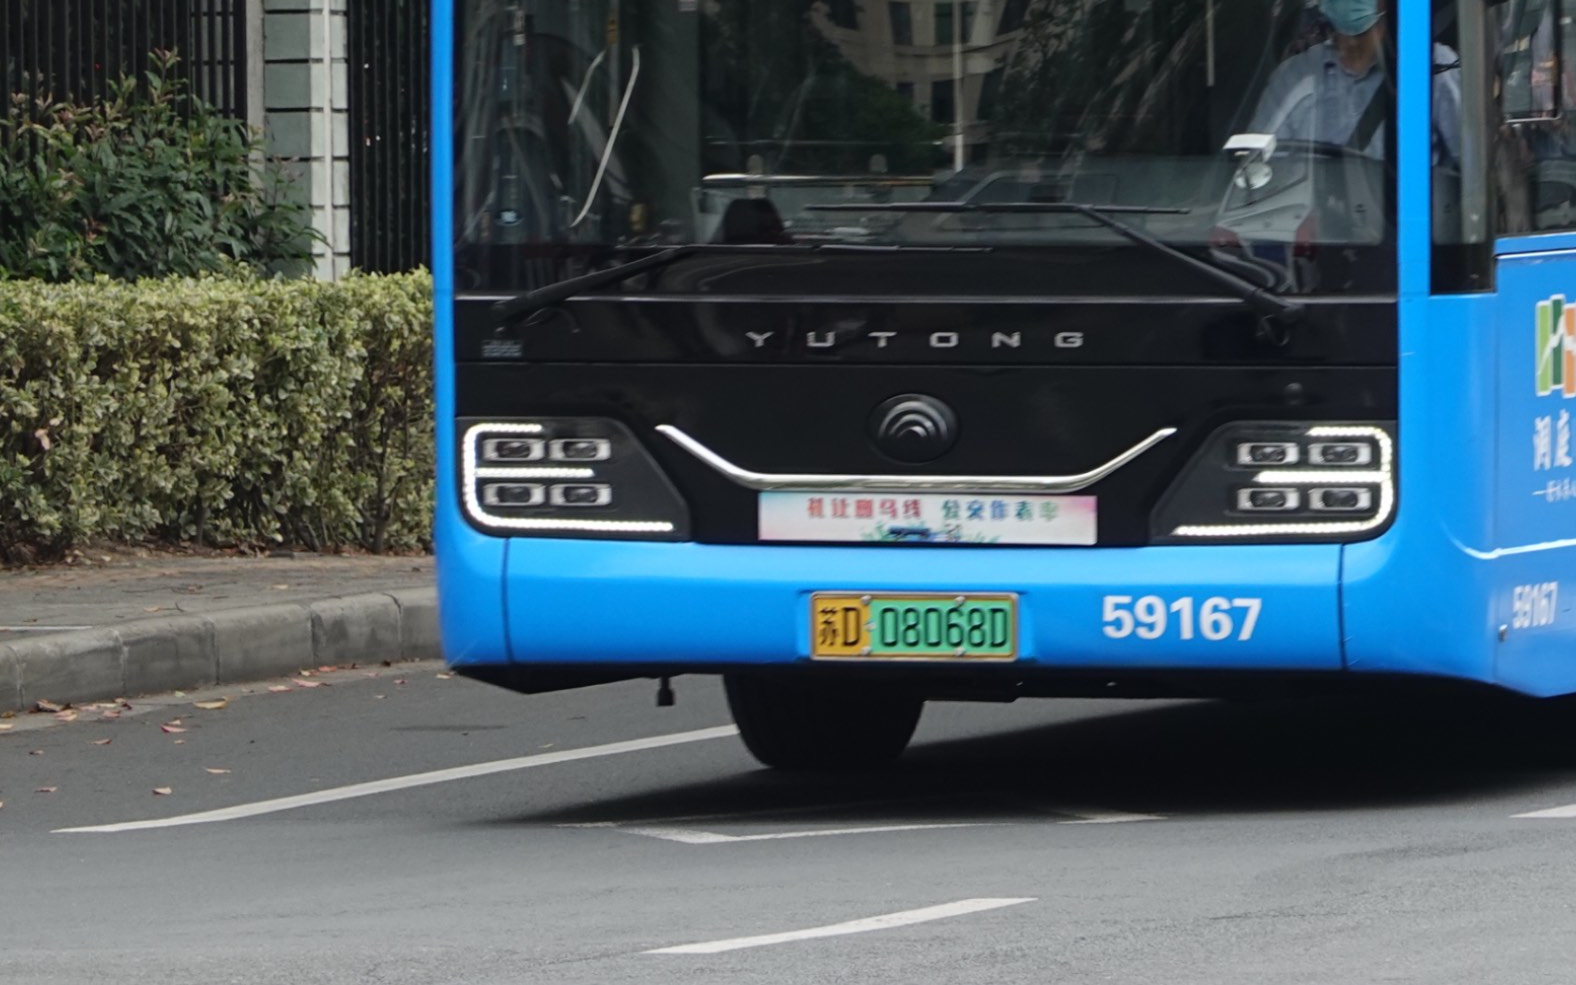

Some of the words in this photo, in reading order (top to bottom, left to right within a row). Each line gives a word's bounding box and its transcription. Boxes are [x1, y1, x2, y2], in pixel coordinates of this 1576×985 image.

[745, 331, 1085, 348] YUTONG
[1102, 595, 1263, 641] 59167
[1512, 581, 1558, 629] 59167
